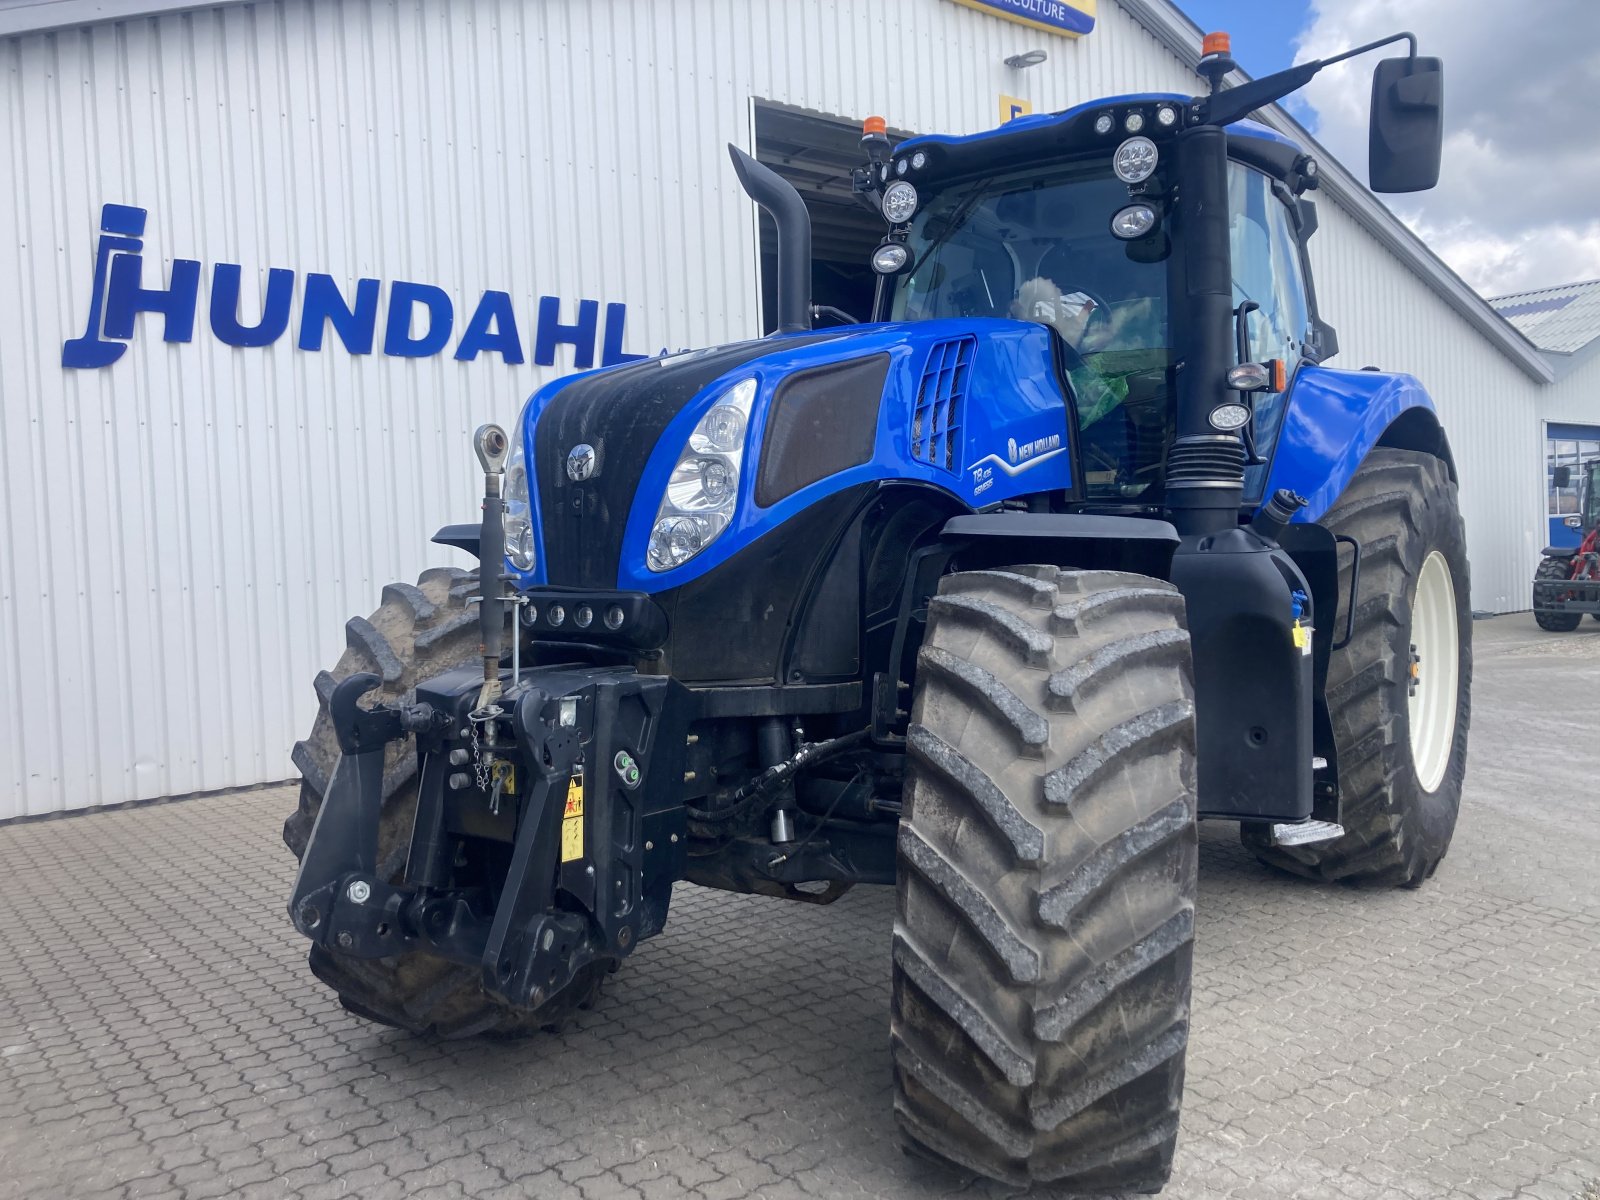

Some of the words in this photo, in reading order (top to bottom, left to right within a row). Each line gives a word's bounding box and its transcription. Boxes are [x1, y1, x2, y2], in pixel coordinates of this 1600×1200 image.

[1019, 442, 1034, 461] NEW
[1034, 434, 1060, 454] HOLLAND
[974, 478, 993, 496] GENESIS
